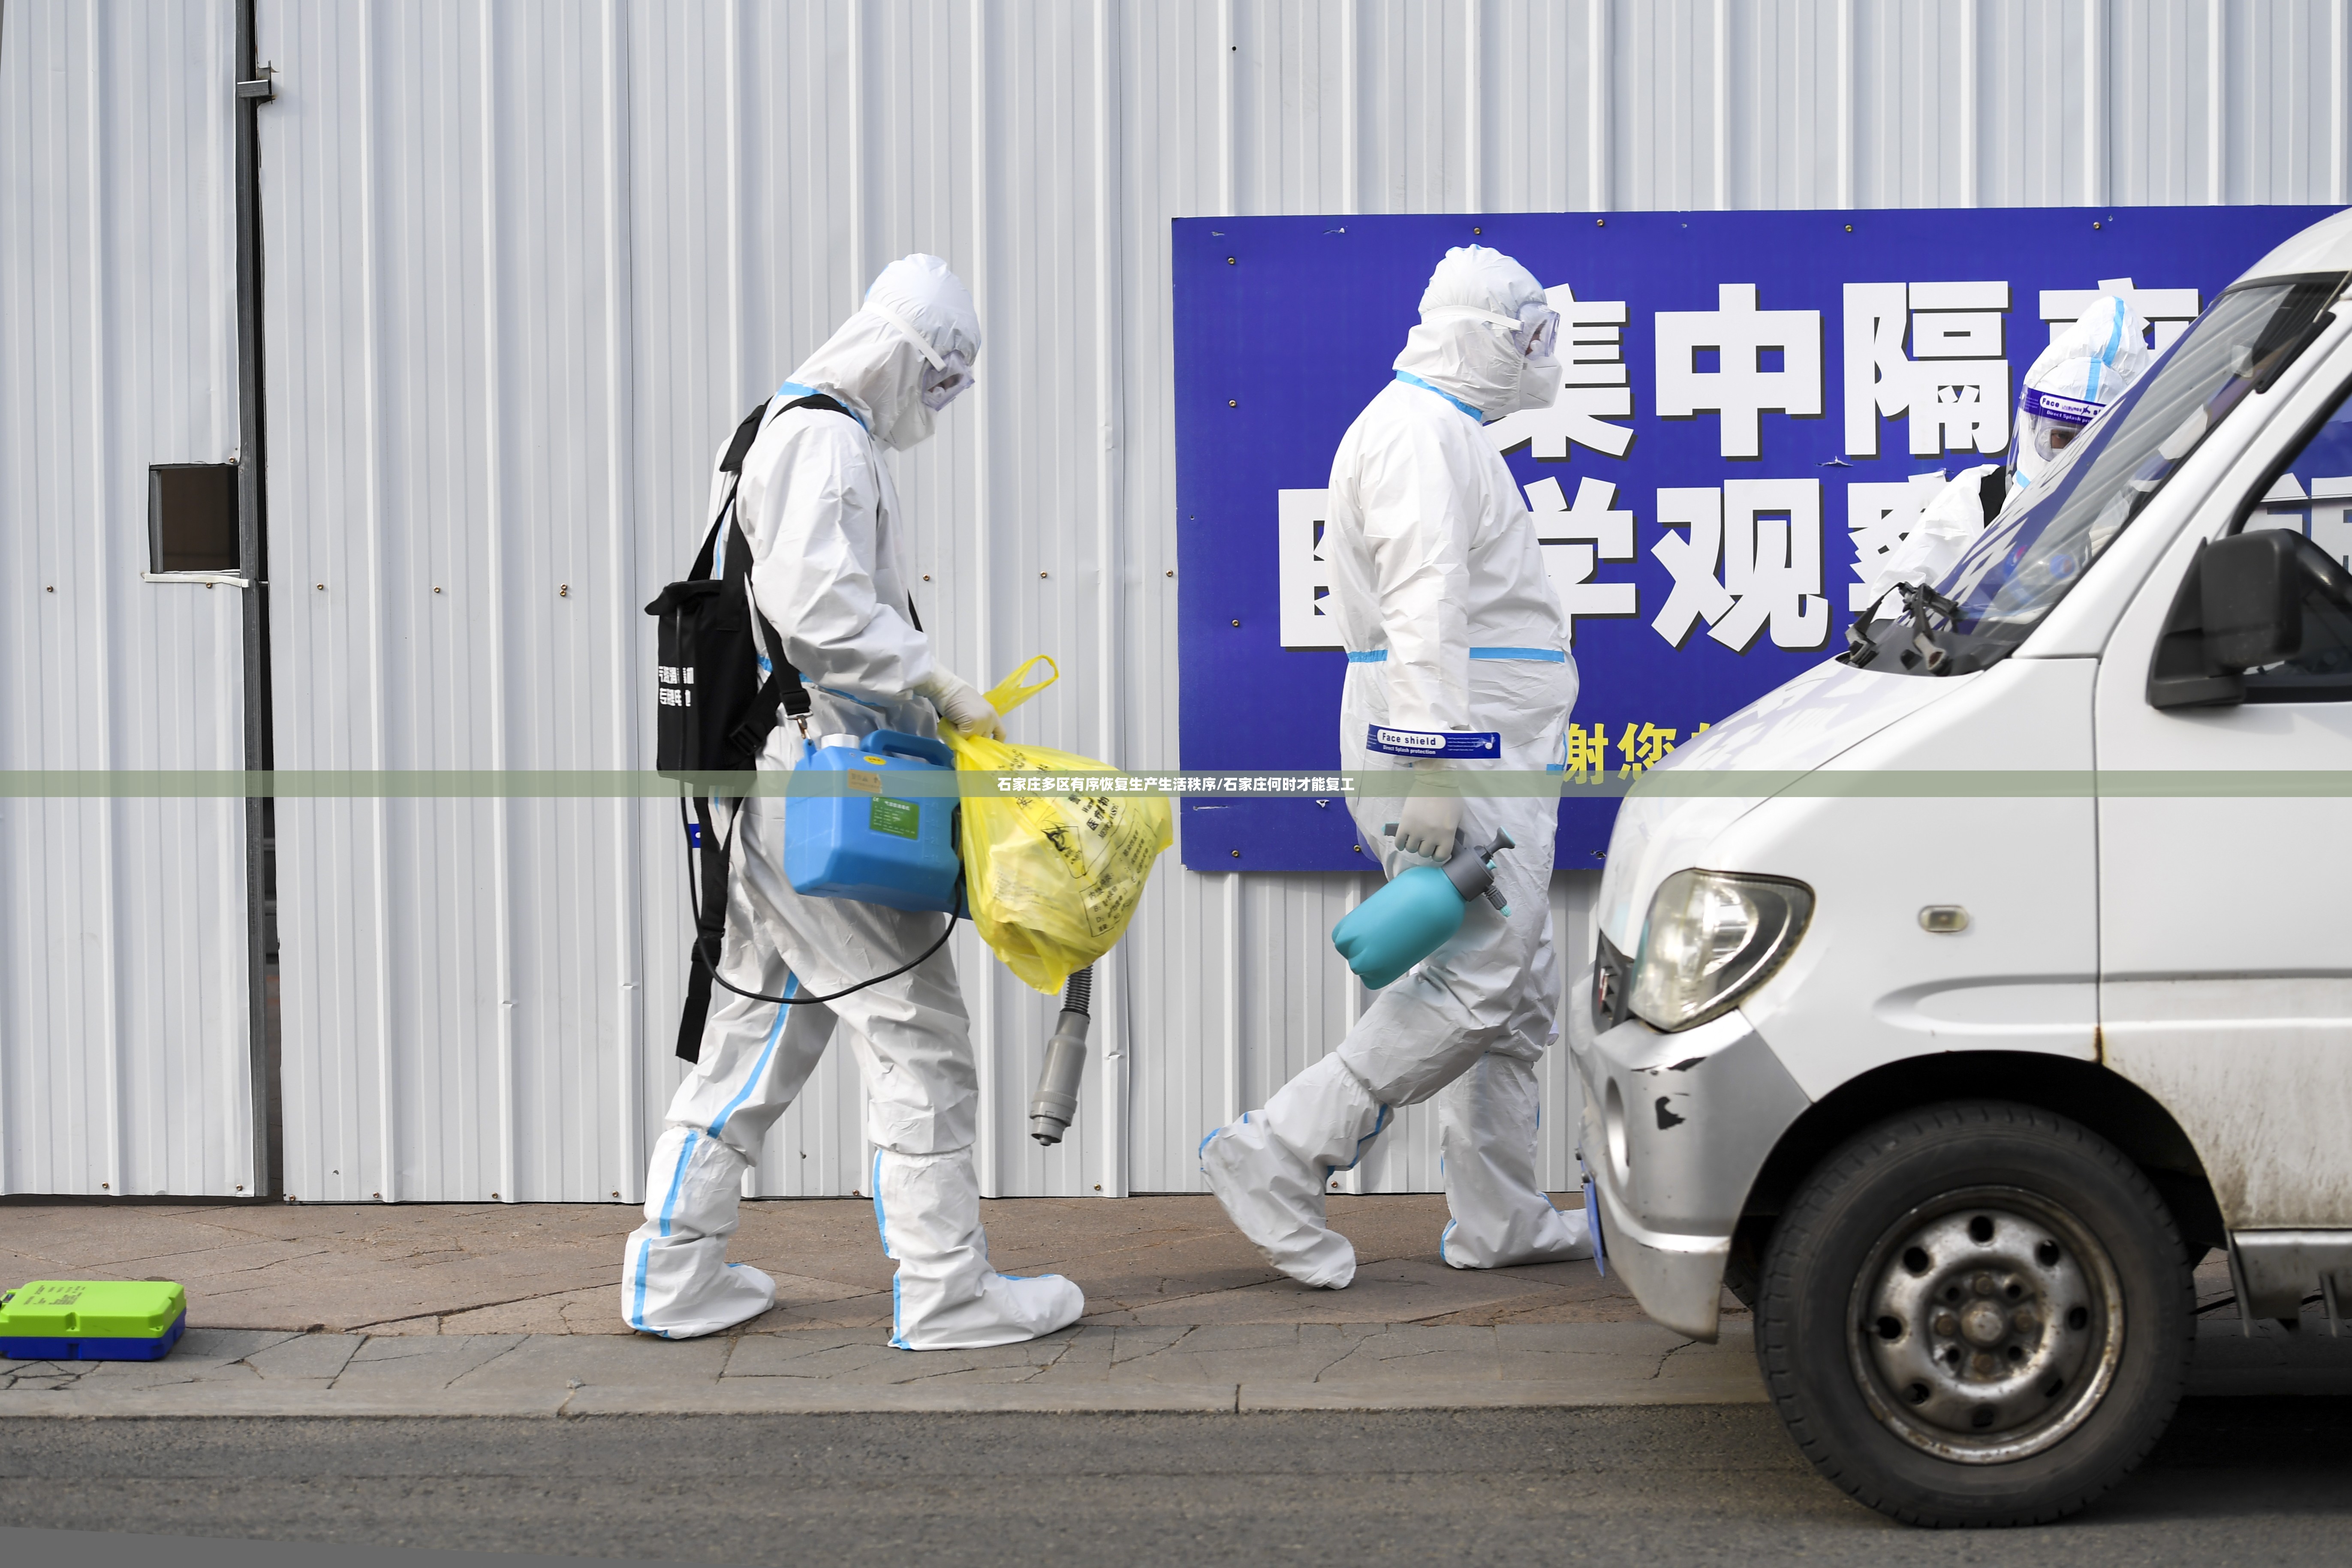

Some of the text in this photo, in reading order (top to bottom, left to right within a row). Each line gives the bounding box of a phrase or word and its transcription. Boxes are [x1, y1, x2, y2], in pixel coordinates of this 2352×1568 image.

[2042, 398, 2060, 408] Face
[2063, 413, 2081, 422] Splash
[1382, 732, 1401, 743] Face
[1405, 736, 1436, 746] shield
